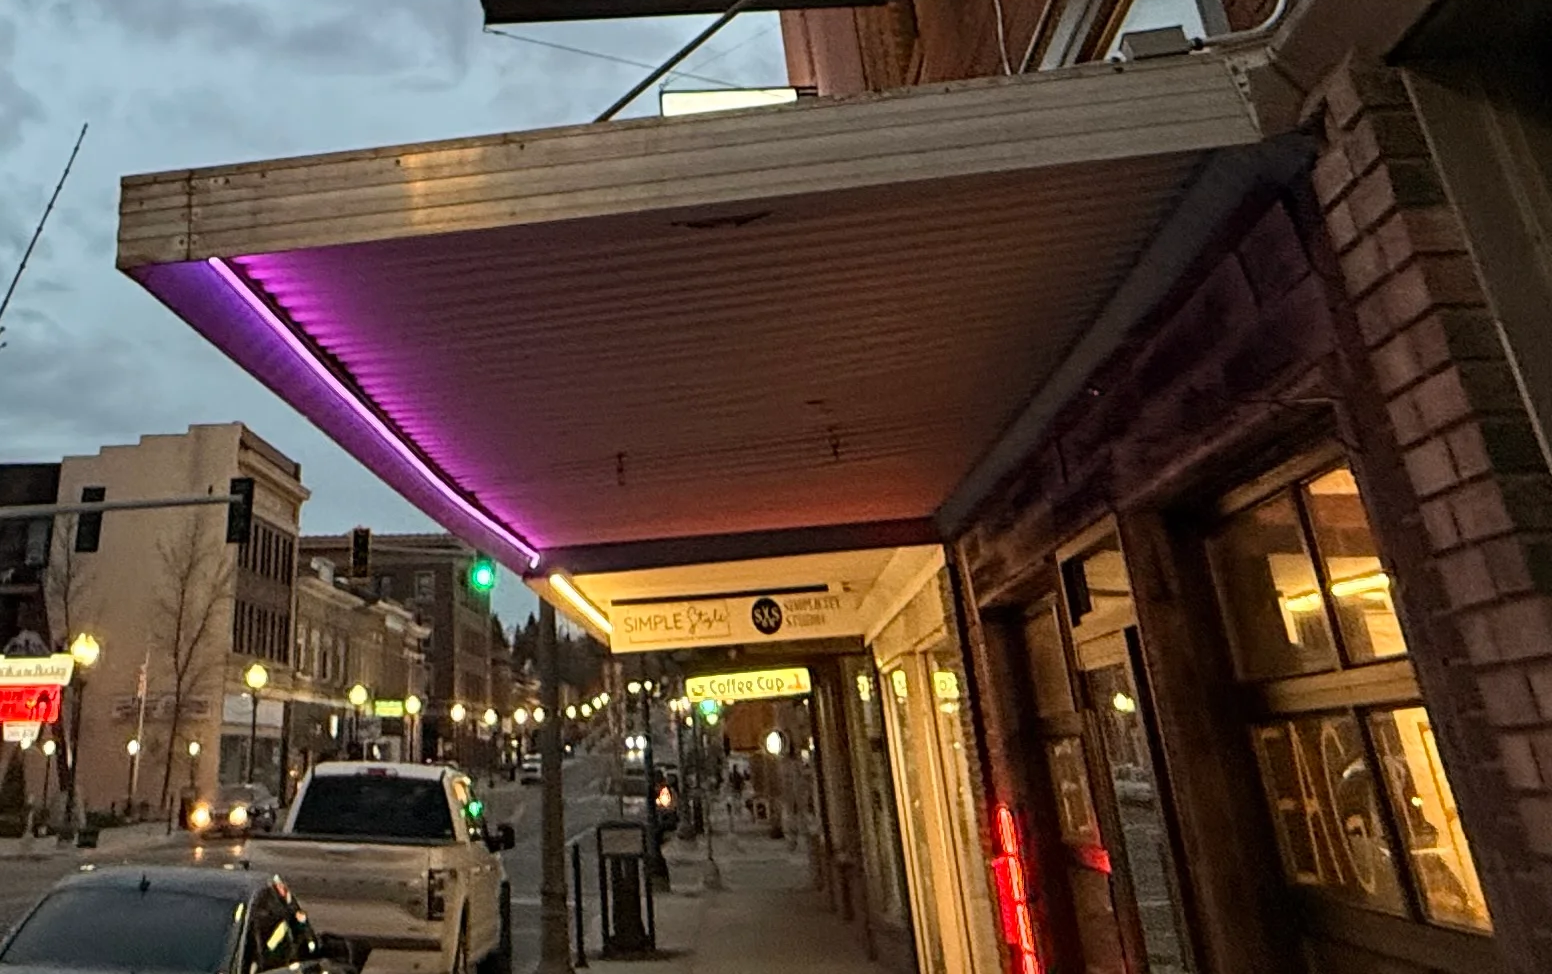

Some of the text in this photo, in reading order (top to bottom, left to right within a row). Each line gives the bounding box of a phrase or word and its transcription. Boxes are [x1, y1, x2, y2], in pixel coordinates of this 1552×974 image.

[623, 606, 726, 634] SIMPLE Style
[709, 676, 785, 695] Coffee Cup
